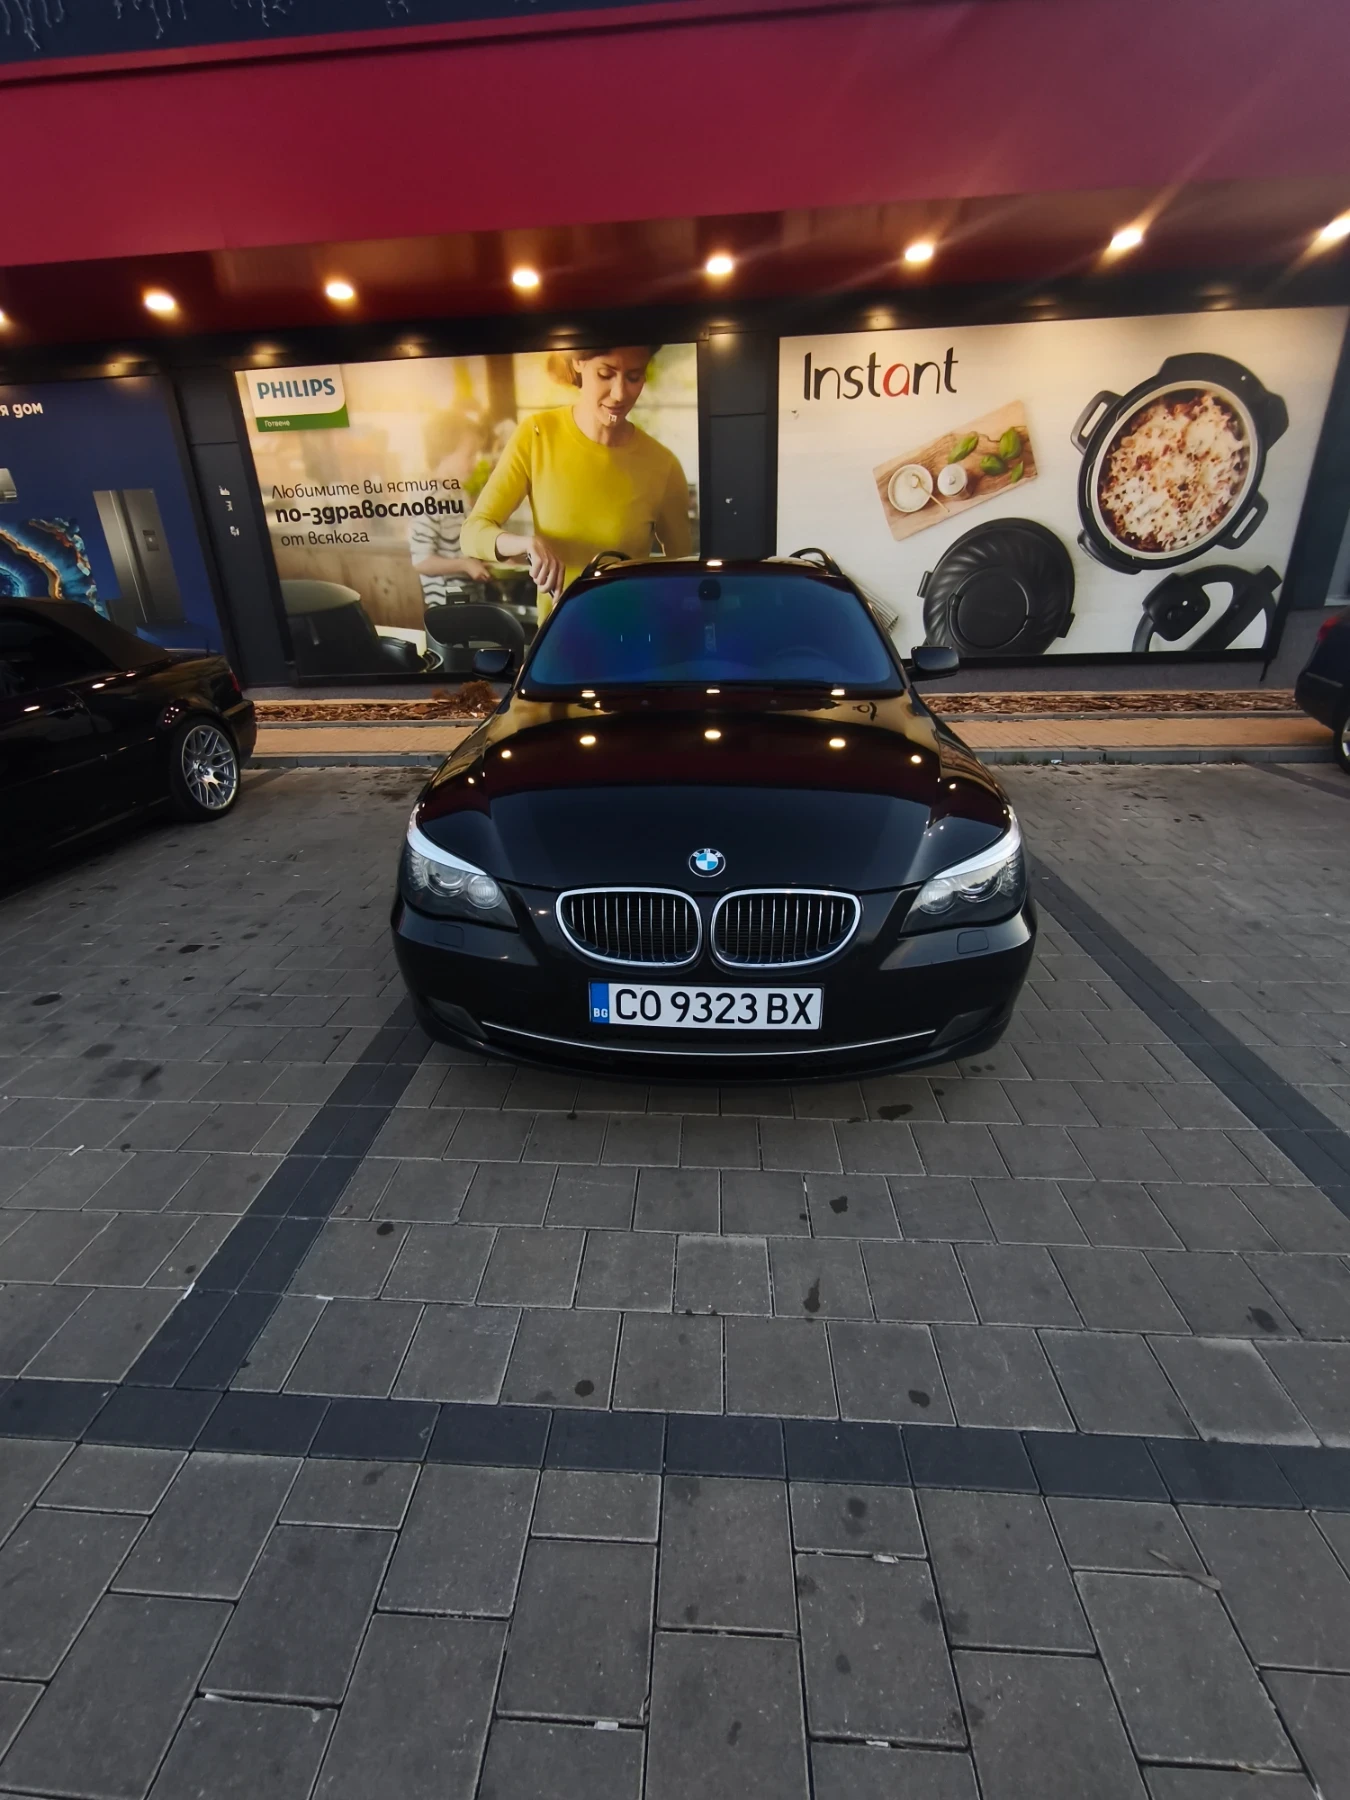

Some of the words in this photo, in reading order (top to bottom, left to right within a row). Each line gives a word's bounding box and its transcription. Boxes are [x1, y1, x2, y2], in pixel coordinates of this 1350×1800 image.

[803, 347, 959, 401] Instant
[256, 378, 336, 399] PHILIPS
[12, 402, 44, 419] дом
[271, 483, 360, 500] Любимите
[363, 479, 383, 494] ви
[387, 479, 438, 493] ястия
[442, 478, 462, 490] са
[275, 496, 464, 525] по-здравословни
[281, 533, 305, 547] от
[308, 530, 370, 545] всякога
[593, 1007, 609, 1018] BG
[670, 991, 759, 1025] 9323
[766, 993, 815, 1025] BX
